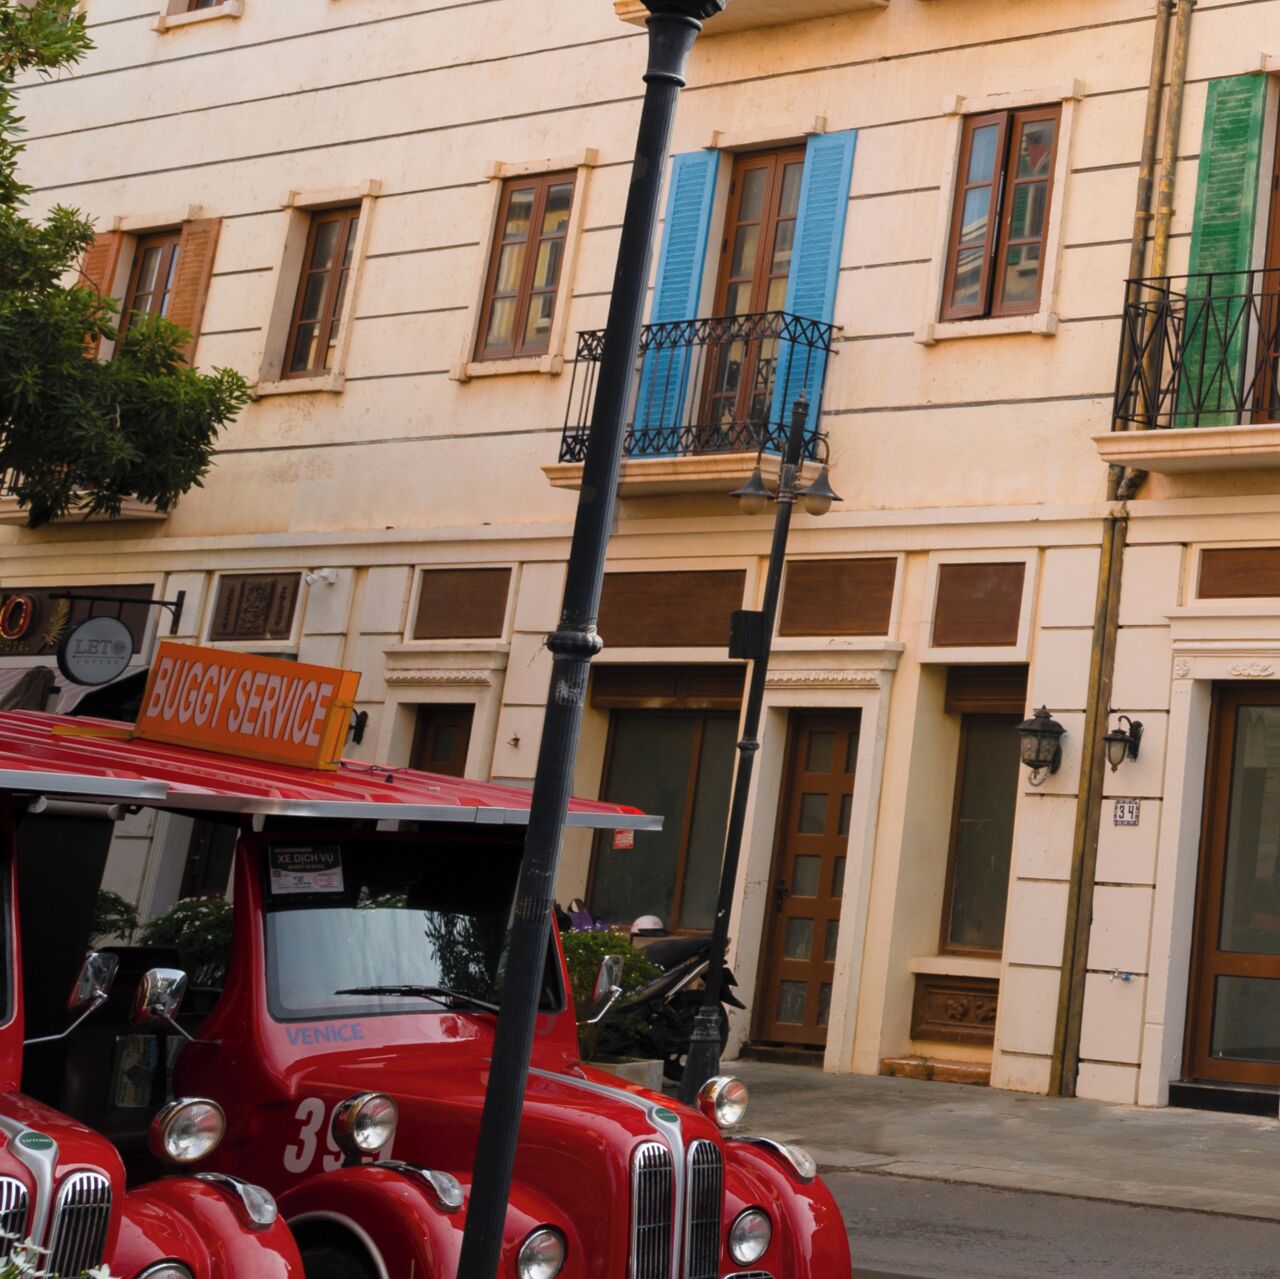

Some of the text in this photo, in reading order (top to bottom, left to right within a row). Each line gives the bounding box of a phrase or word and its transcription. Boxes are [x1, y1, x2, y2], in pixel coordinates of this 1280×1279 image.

[147, 656, 334, 747] BUGGY SERVICE
[1119, 805, 1135, 819] 34
[285, 1022, 365, 1046] VENICE
